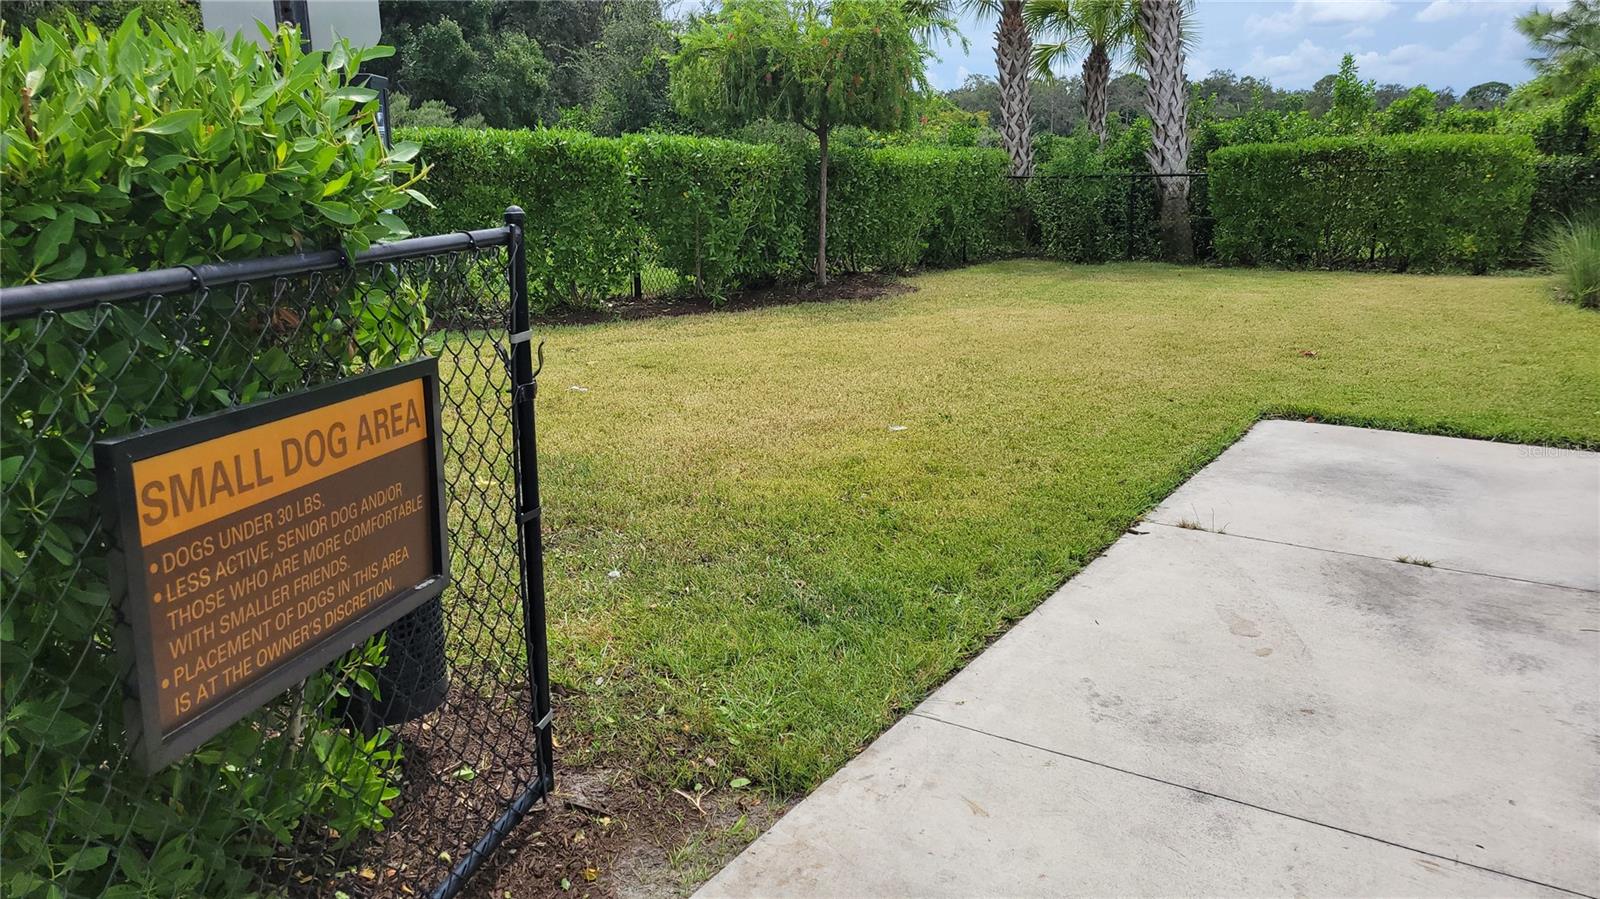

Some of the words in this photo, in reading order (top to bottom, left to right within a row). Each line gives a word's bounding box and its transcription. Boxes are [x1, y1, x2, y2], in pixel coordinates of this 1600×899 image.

[141, 448, 273, 527] SMALL
[281, 421, 348, 474] DOG
[357, 398, 420, 451] AREA
[163, 536, 214, 573] DOGS
[220, 512, 273, 549] UNDER
[277, 507, 294, 527] 30
[296, 492, 325, 519] LBS.
[167, 567, 210, 603] LESS
[216, 541, 274, 577] ACTIVE,
[276, 517, 328, 551] SENIOR
[331, 501, 357, 528] DOG
[360, 482, 402, 513] AND/OR
[167, 590, 226, 630] THOSE
[229, 572, 268, 604] WHO
[272, 558, 300, 583] ARE
[304, 537, 341, 569] MORE
[344, 494, 423, 545] COMFORTABLE
[169, 623, 215, 659] WITH
[220, 584, 290, 634] SMALLER
[294, 556, 351, 598] FRIENDS.
[173, 623, 272, 688] PLACEMENT
[275, 609, 294, 631] OF
[298, 587, 335, 618] DOGS
[338, 577, 350, 596] IN
[353, 563, 378, 589] THIS
[380, 546, 408, 576] AREA
[175, 690, 191, 715] IS
[196, 675, 220, 701] AT
[222, 659, 252, 690] THE
[257, 619, 322, 667] OWNER'S
[324, 576, 395, 624] DISCRETION.
